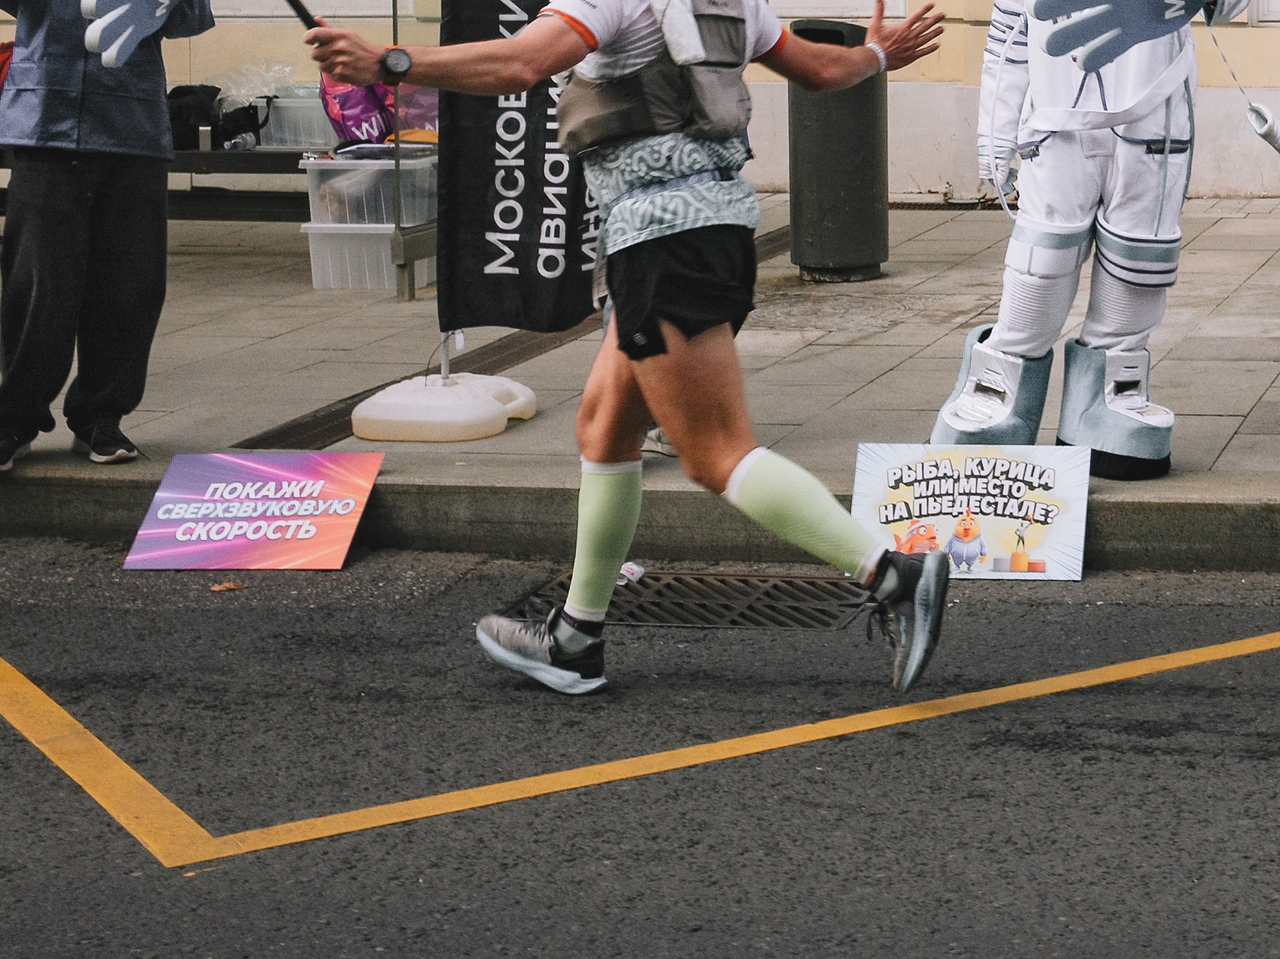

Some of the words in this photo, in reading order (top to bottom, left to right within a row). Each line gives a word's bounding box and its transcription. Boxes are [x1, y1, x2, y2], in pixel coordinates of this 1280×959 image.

[887, 458, 960, 489] РЫБА,
[964, 457, 1056, 490] КУРИЦА
[203, 480, 325, 500] ПОКАЖИ
[913, 480, 956, 500] ИЛИ
[958, 477, 1027, 500] МЕСТО
[156, 498, 356, 520] СВЕРХЗВУКОВУЮ
[878, 501, 912, 524] НА
[912, 495, 1060, 524] ПЬЕДЕСТАЛЕ?
[175, 519, 318, 542] СКОРОСТЬ
